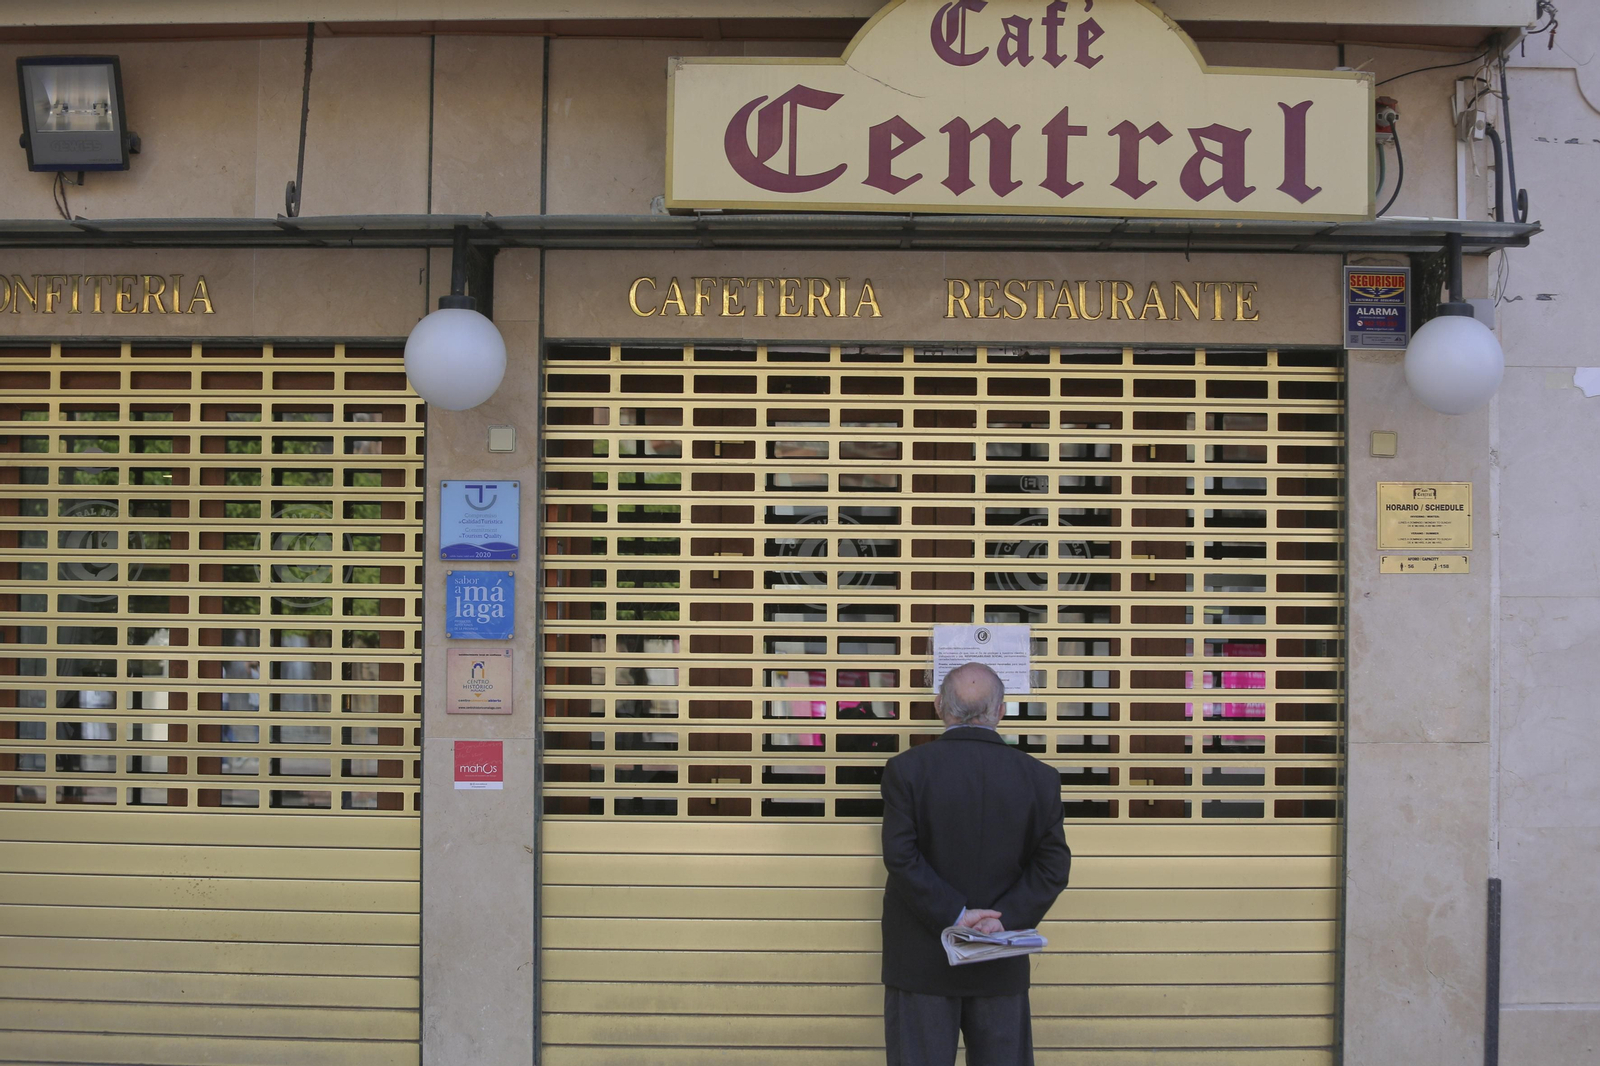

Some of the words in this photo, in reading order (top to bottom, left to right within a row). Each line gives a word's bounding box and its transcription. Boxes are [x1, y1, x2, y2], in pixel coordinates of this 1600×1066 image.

[724, 84, 1322, 204] Central
[1350, 274, 1405, 288] SEGURISUR
[628, 276, 883, 318] CAFETERIA
[944, 278, 1260, 321] RESTAURANTE
[1356, 307, 1399, 316] ALARMA
[454, 575, 480, 584] sabor
[454, 585, 462, 594] a
[463, 579, 506, 602] má
[455, 596, 506, 624] laga
